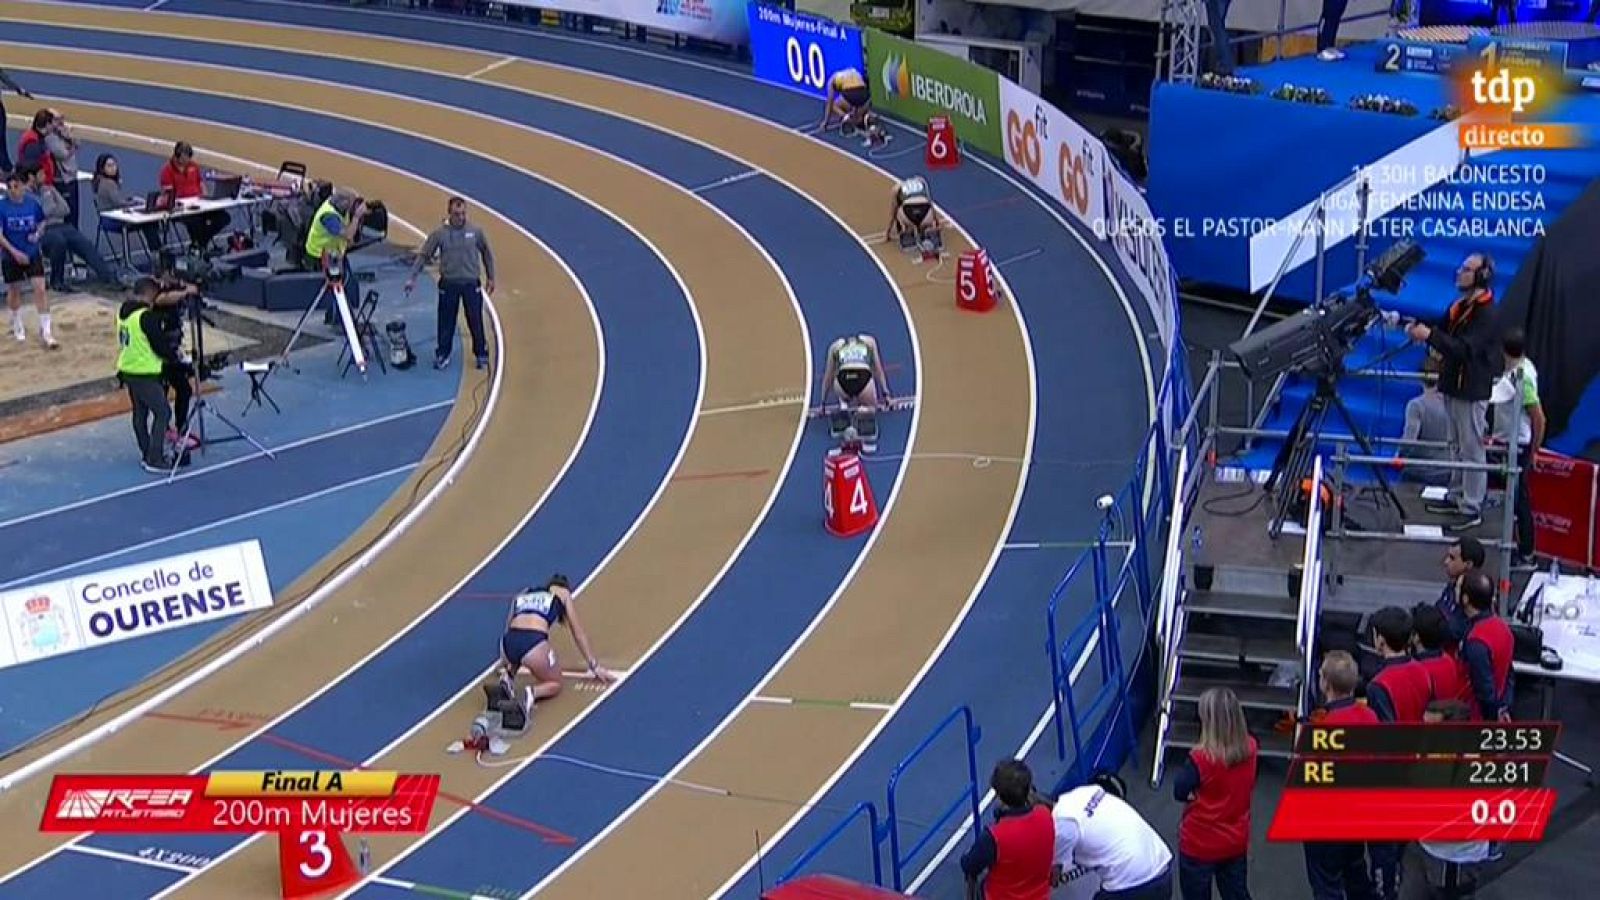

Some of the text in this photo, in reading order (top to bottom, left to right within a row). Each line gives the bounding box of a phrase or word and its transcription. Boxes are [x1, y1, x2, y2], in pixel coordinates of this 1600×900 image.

[787, 36, 825, 89] 0.0
[1385, 42, 1400, 70] 2
[911, 73, 987, 125] IBERDROLA
[930, 133, 948, 159] 6
[1008, 109, 1041, 177] GO
[1059, 141, 1088, 216] GO
[960, 271, 976, 301] 5
[850, 476, 868, 514] 4
[82, 561, 215, 604] Concello de
[89, 581, 245, 637] OURENSE
[299, 830, 332, 878] 3
